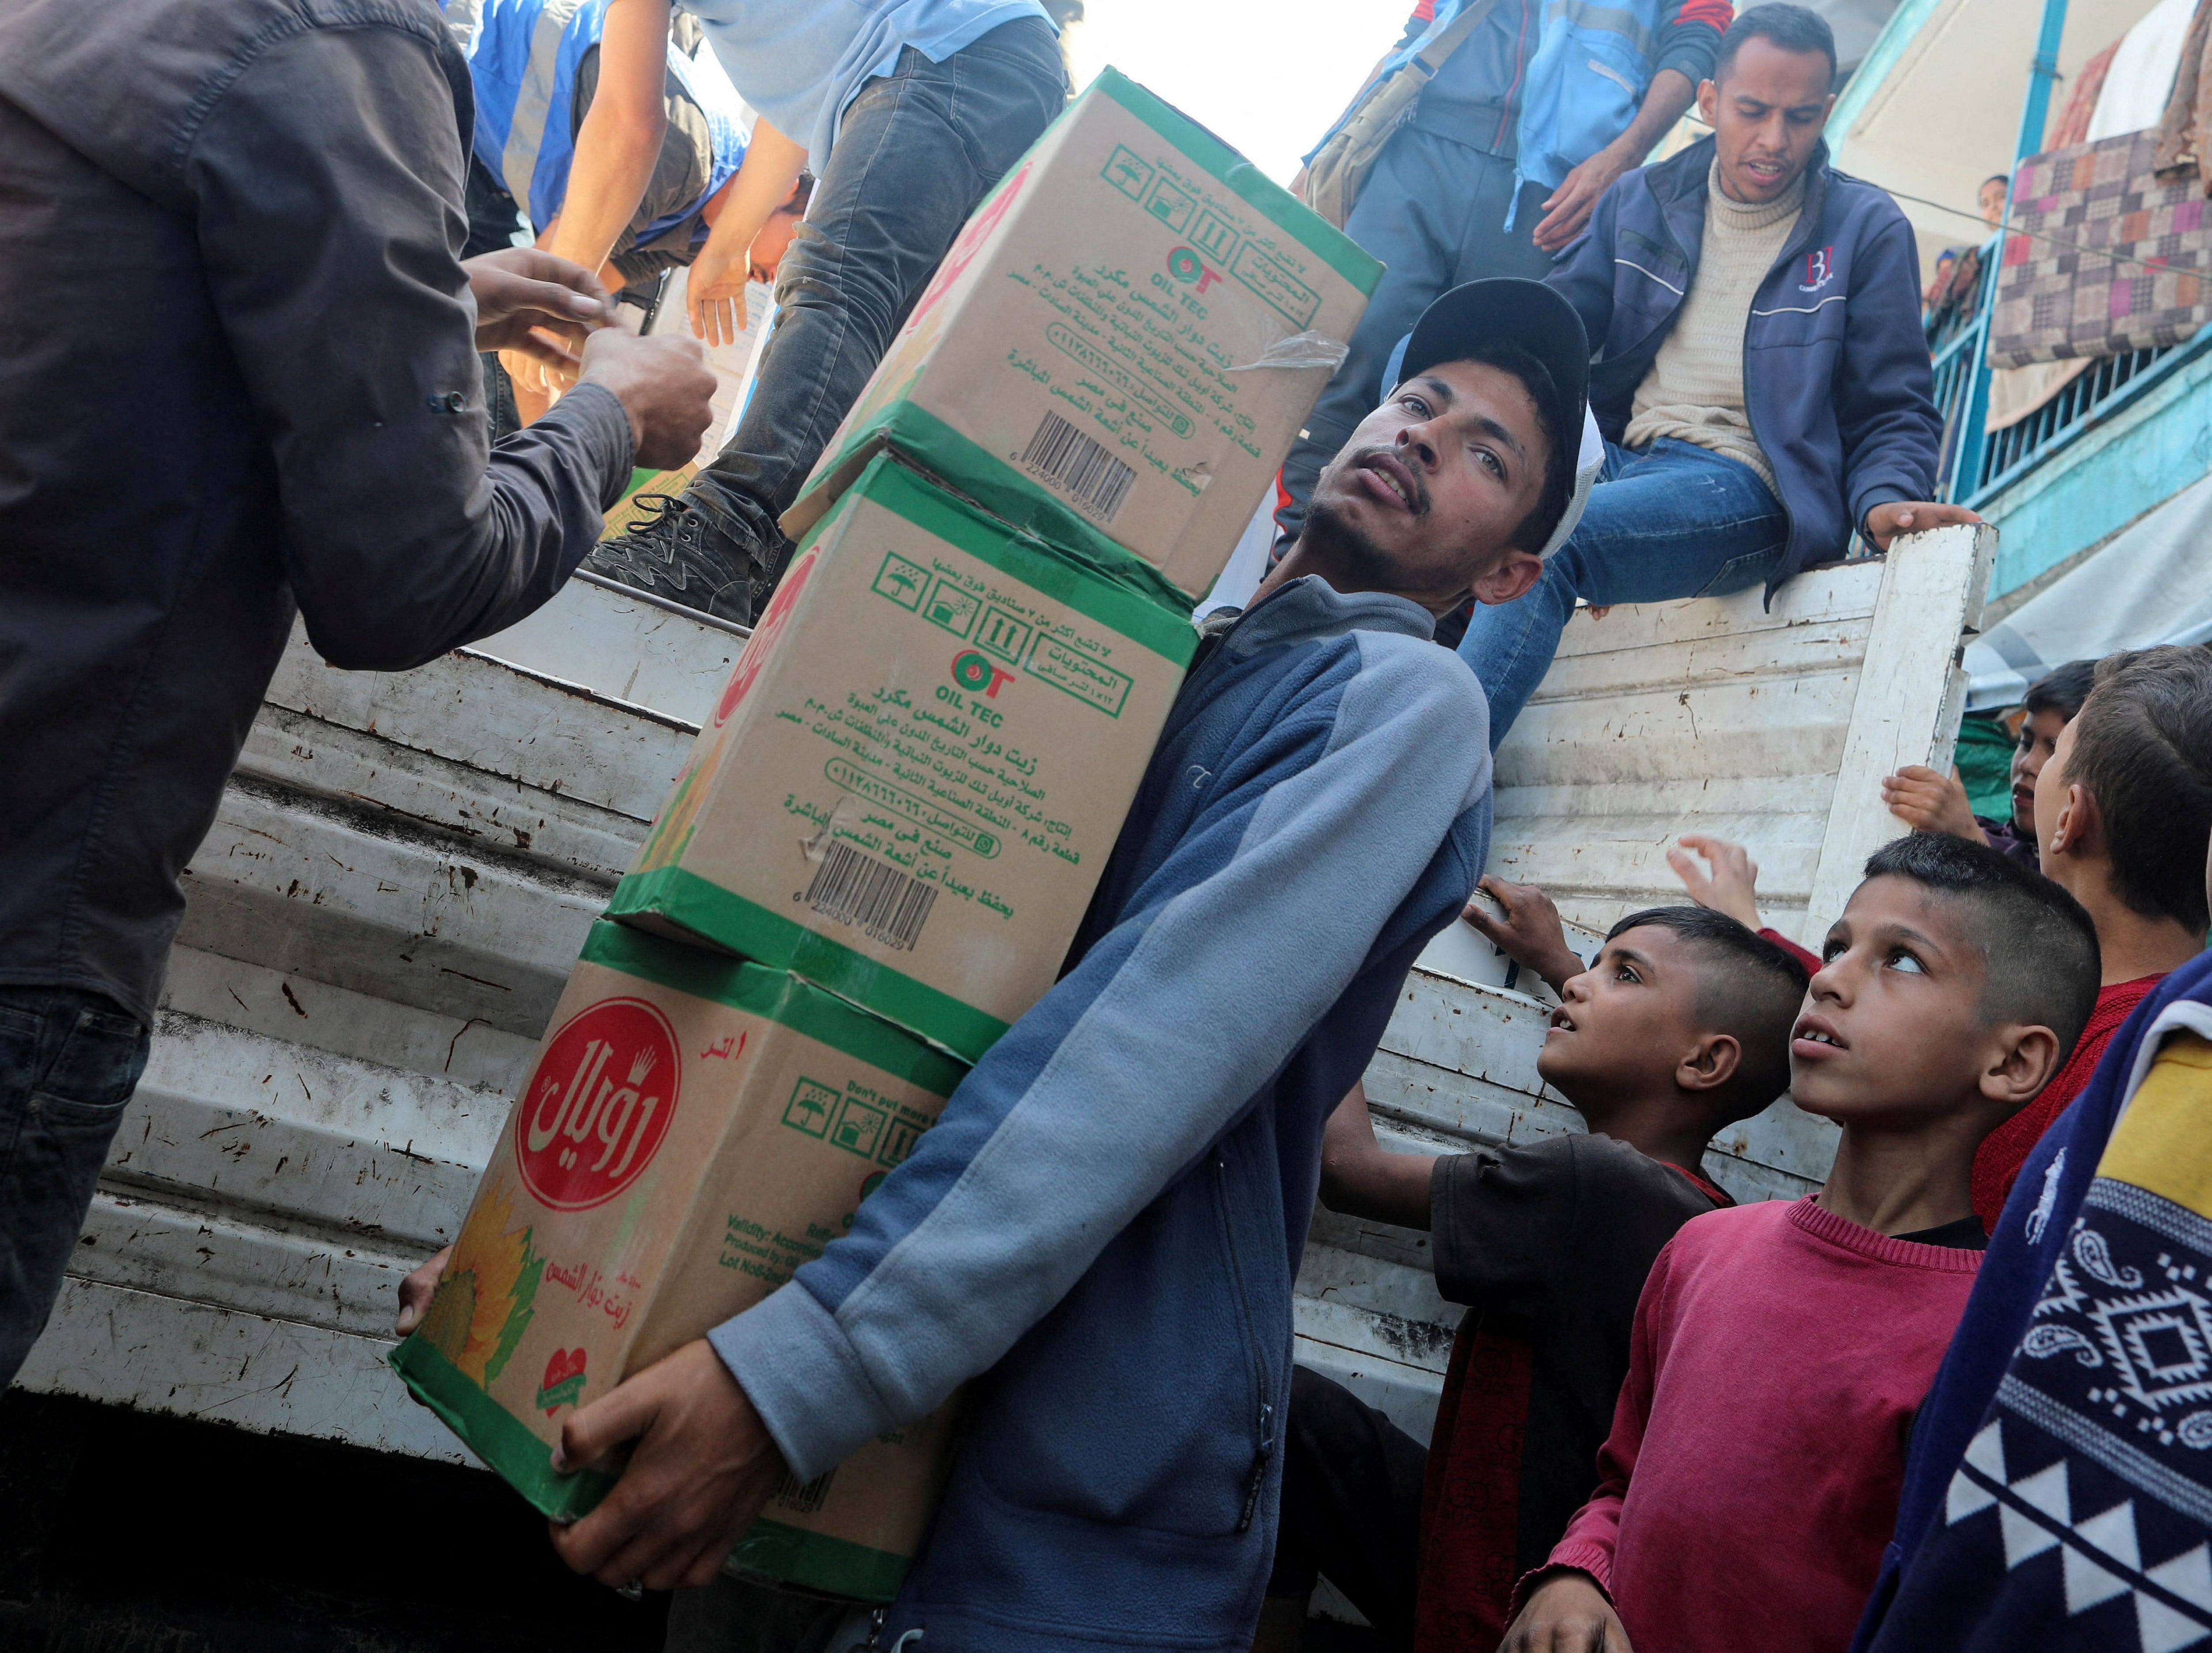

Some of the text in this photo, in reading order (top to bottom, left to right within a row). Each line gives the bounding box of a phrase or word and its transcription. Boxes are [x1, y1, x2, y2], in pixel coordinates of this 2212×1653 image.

[1252, 256, 1308, 300] المحتويات
[1151, 273, 1208, 320] OIL TEC
[1095, 266, 1233, 369] زيت دوار الشمس مكرر
[1175, 345, 1196, 362] حسب
[1008, 350, 1050, 383] المباشرة
[1198, 359, 1237, 392] الصلاحية
[1076, 380, 1105, 396] مصر
[1050, 388, 1093, 412] الشمس
[1125, 411, 1152, 432] صنع
[1120, 433, 1138, 449] عن
[1026, 463, 1061, 489] 224000
[1071, 494, 1104, 520] 016029
[933, 559, 962, 580] بعضها
[965, 577, 985, 592] فوق
[987, 589, 1026, 614] صناديق
[1035, 616, 1051, 627] من
[1075, 637, 1099, 652] تضع
[1102, 646, 1111, 657] لا
[1048, 647, 1117, 686] المحتويات
[847, 693, 878, 713] العبوة
[936, 686, 1003, 728] OIL TEC
[776, 711, 803, 723] مصر
[812, 723, 850, 747] السادات
[873, 688, 1037, 776] زيت دوار الشمس مكرر
[899, 724, 930, 742] المدون
[853, 742, 883, 765] مدينة
[892, 740, 931, 764] النباتية
[930, 737, 968, 759] التاريخ
[893, 762, 926, 784] الثانية
[933, 761, 968, 784] للزيوت
[968, 759, 995, 775] حسب
[928, 780, 972, 808] الصناعية
[968, 780, 988, 794] تك
[998, 769, 1045, 799] الصلاحية
[987, 790, 1015, 808] أويل
[862, 815, 894, 830] مصر
[975, 805, 1010, 828] المنطقة
[1015, 802, 1042, 823] شركة
[832, 829, 881, 849] الشمس
[1029, 836, 1049, 851] رقم
[884, 843, 923, 866] أشعة
[920, 840, 952, 868] صنع
[1052, 844, 1080, 864] قطعة
[916, 863, 937, 880] عن
[978, 891, 1013, 919] يحفظ
[793, 892, 904, 950] 6 224000 016029
[847, 1080, 877, 1102] Don't
[878, 1096, 899, 1111] put
[900, 1105, 929, 1124] more
[725, 1232, 770, 1258] Produced
[728, 1214, 825, 1258] Validity: Accordin
[718, 1250, 740, 1270] Lot
[545, 1262, 588, 1293] الشمس
[604, 1295, 633, 1330] زيت
